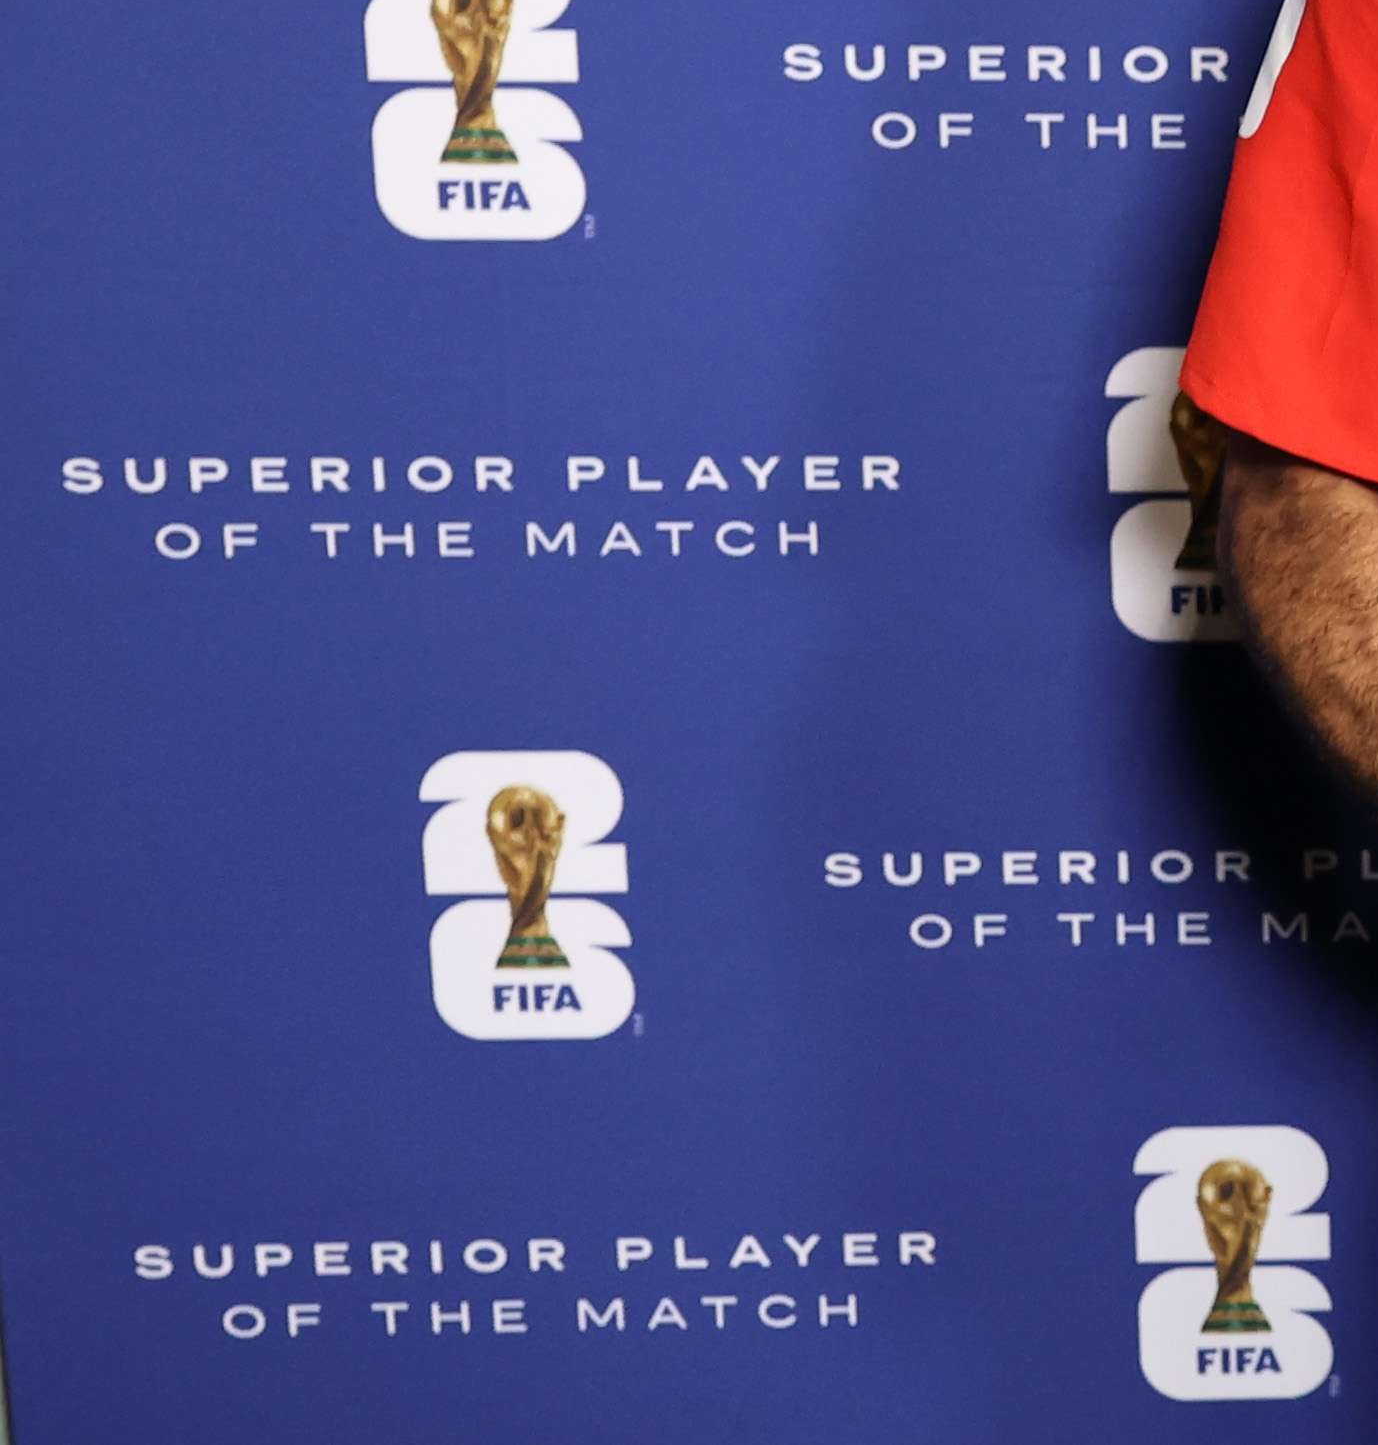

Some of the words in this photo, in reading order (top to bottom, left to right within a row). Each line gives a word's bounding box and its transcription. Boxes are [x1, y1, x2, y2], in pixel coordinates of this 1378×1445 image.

[783, 43, 1229, 83] SUPERIOR
[871, 111, 974, 150] OF
[1024, 112, 1187, 150] THE
[437, 180, 531, 211] FIFA
[62, 455, 514, 495] SUPERIOR
[566, 455, 900, 492] PLAYER
[154, 522, 259, 560] OF
[309, 521, 475, 558] THE
[525, 520, 819, 557] MATCH
[824, 849, 1248, 888] SUPERIOR
[908, 913, 1008, 949] OF
[1056, 912, 1212, 947] THE
[492, 984, 582, 1013] FIFA
[134, 1238, 566, 1280] SUPERIOR
[616, 1231, 937, 1271] PLAYER
[222, 1303, 322, 1339] OF
[370, 1299, 528, 1336] THE
[576, 1293, 858, 1332] MATCH
[1196, 1346, 1283, 1376] FIFA
